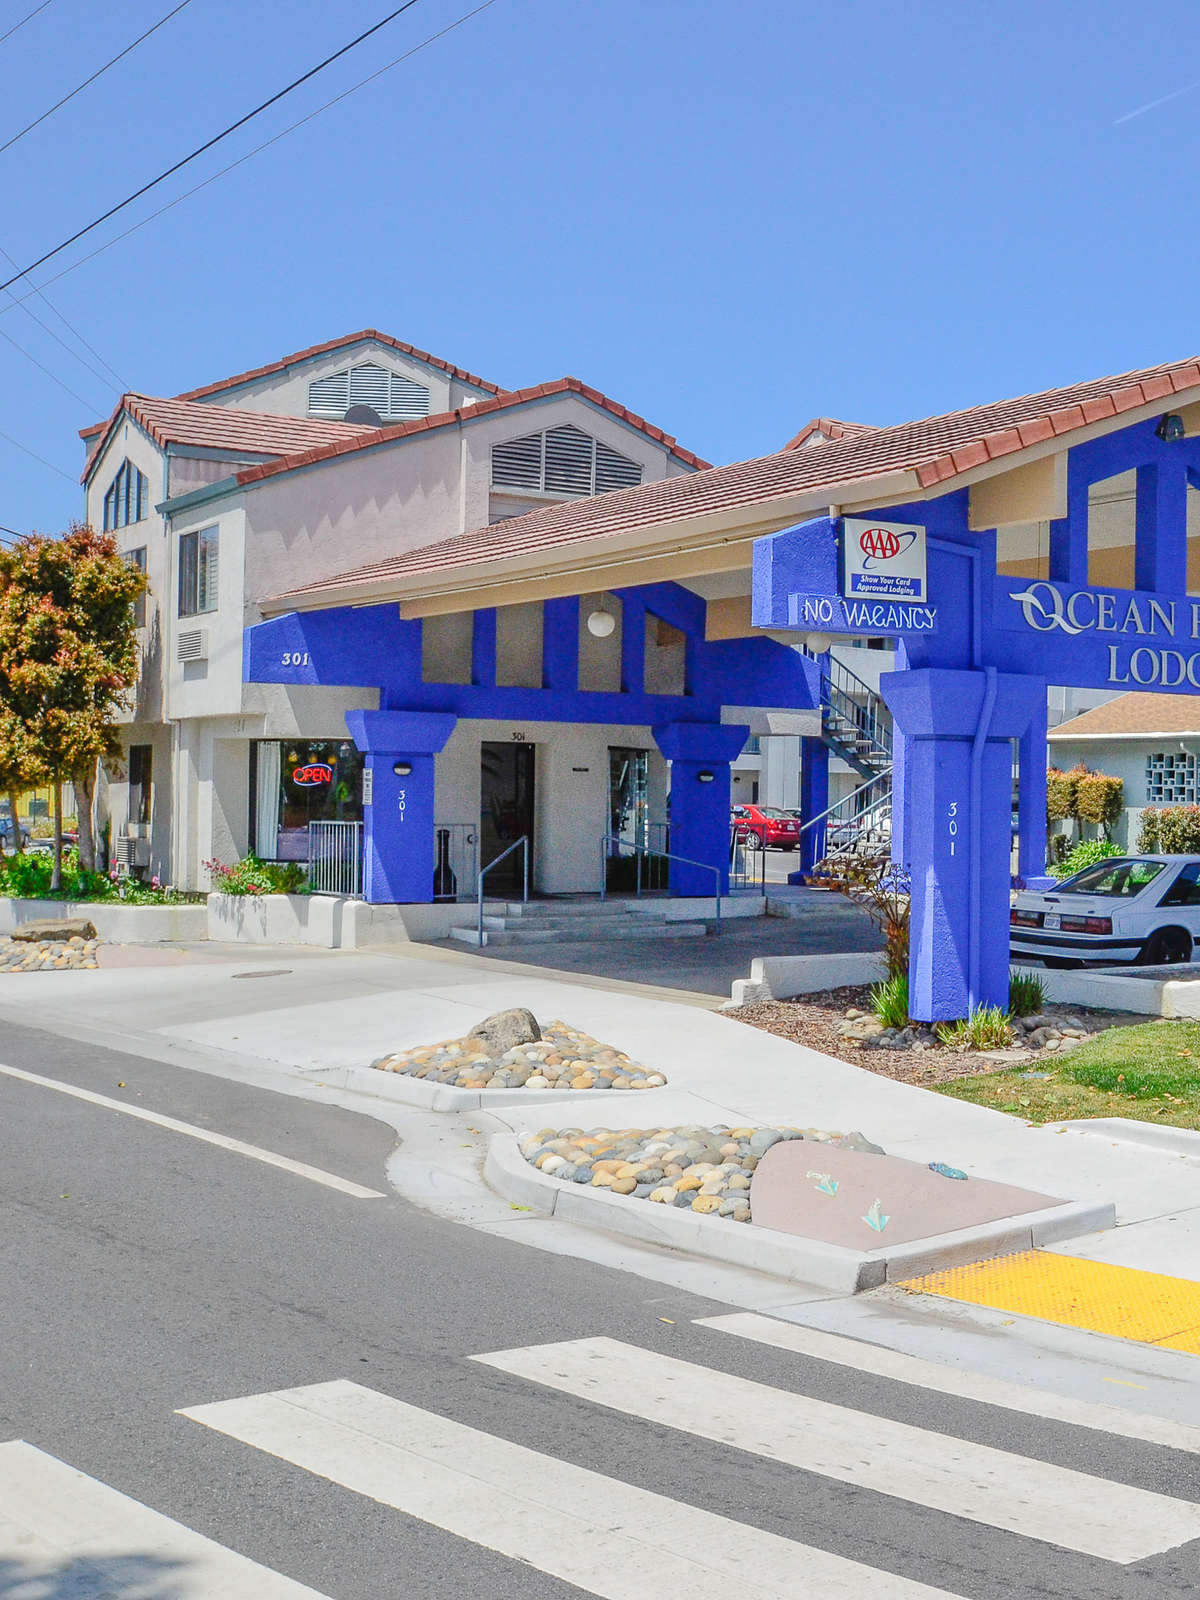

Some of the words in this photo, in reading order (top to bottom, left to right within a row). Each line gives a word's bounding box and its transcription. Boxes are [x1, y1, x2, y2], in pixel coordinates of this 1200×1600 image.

[863, 529, 899, 558] AAA
[860, 574, 879, 583] Show
[879, 576, 894, 585] Your
[895, 578, 911, 586] Card
[856, 582, 888, 592] Approved
[888, 585, 914, 595] Lodging
[804, 599, 833, 622] NO
[841, 601, 937, 629] VACANCY
[281, 652, 309, 666] 301
[511, 732, 526, 741] 301
[292, 767, 331, 782] OPEN
[398, 790, 406, 822] 301
[947, 802, 957, 856] 301
